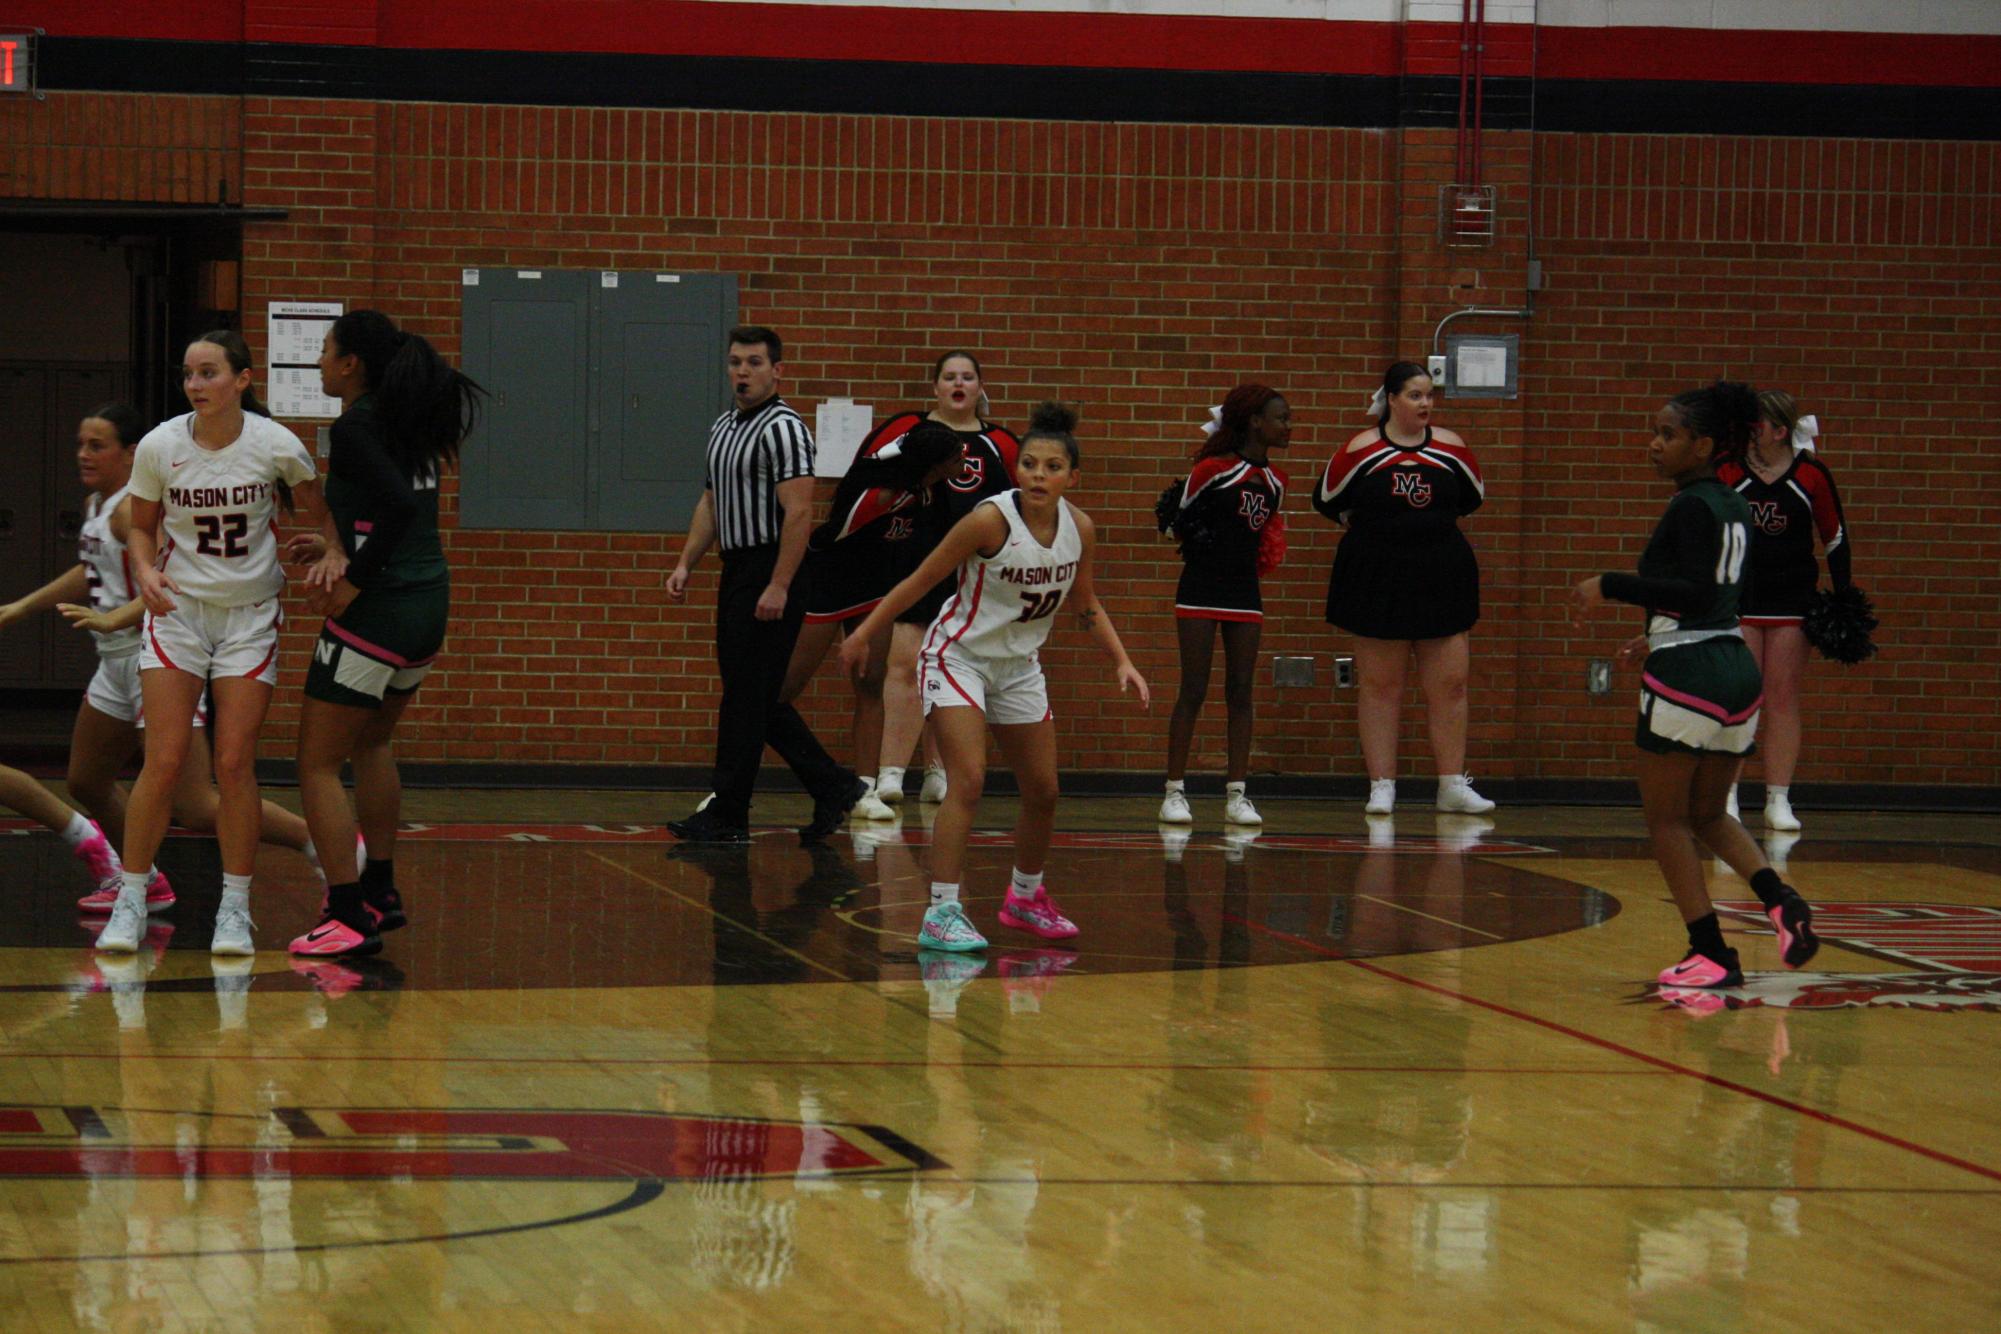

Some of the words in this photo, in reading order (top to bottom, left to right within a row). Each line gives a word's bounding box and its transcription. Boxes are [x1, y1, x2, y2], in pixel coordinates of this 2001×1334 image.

[169, 486, 228, 509] MASON
[232, 482, 268, 506] CITY
[1391, 472, 1432, 508] MC
[1239, 491, 1270, 531] MC
[193, 513, 249, 558] 22
[1000, 565, 1053, 586] MASON
